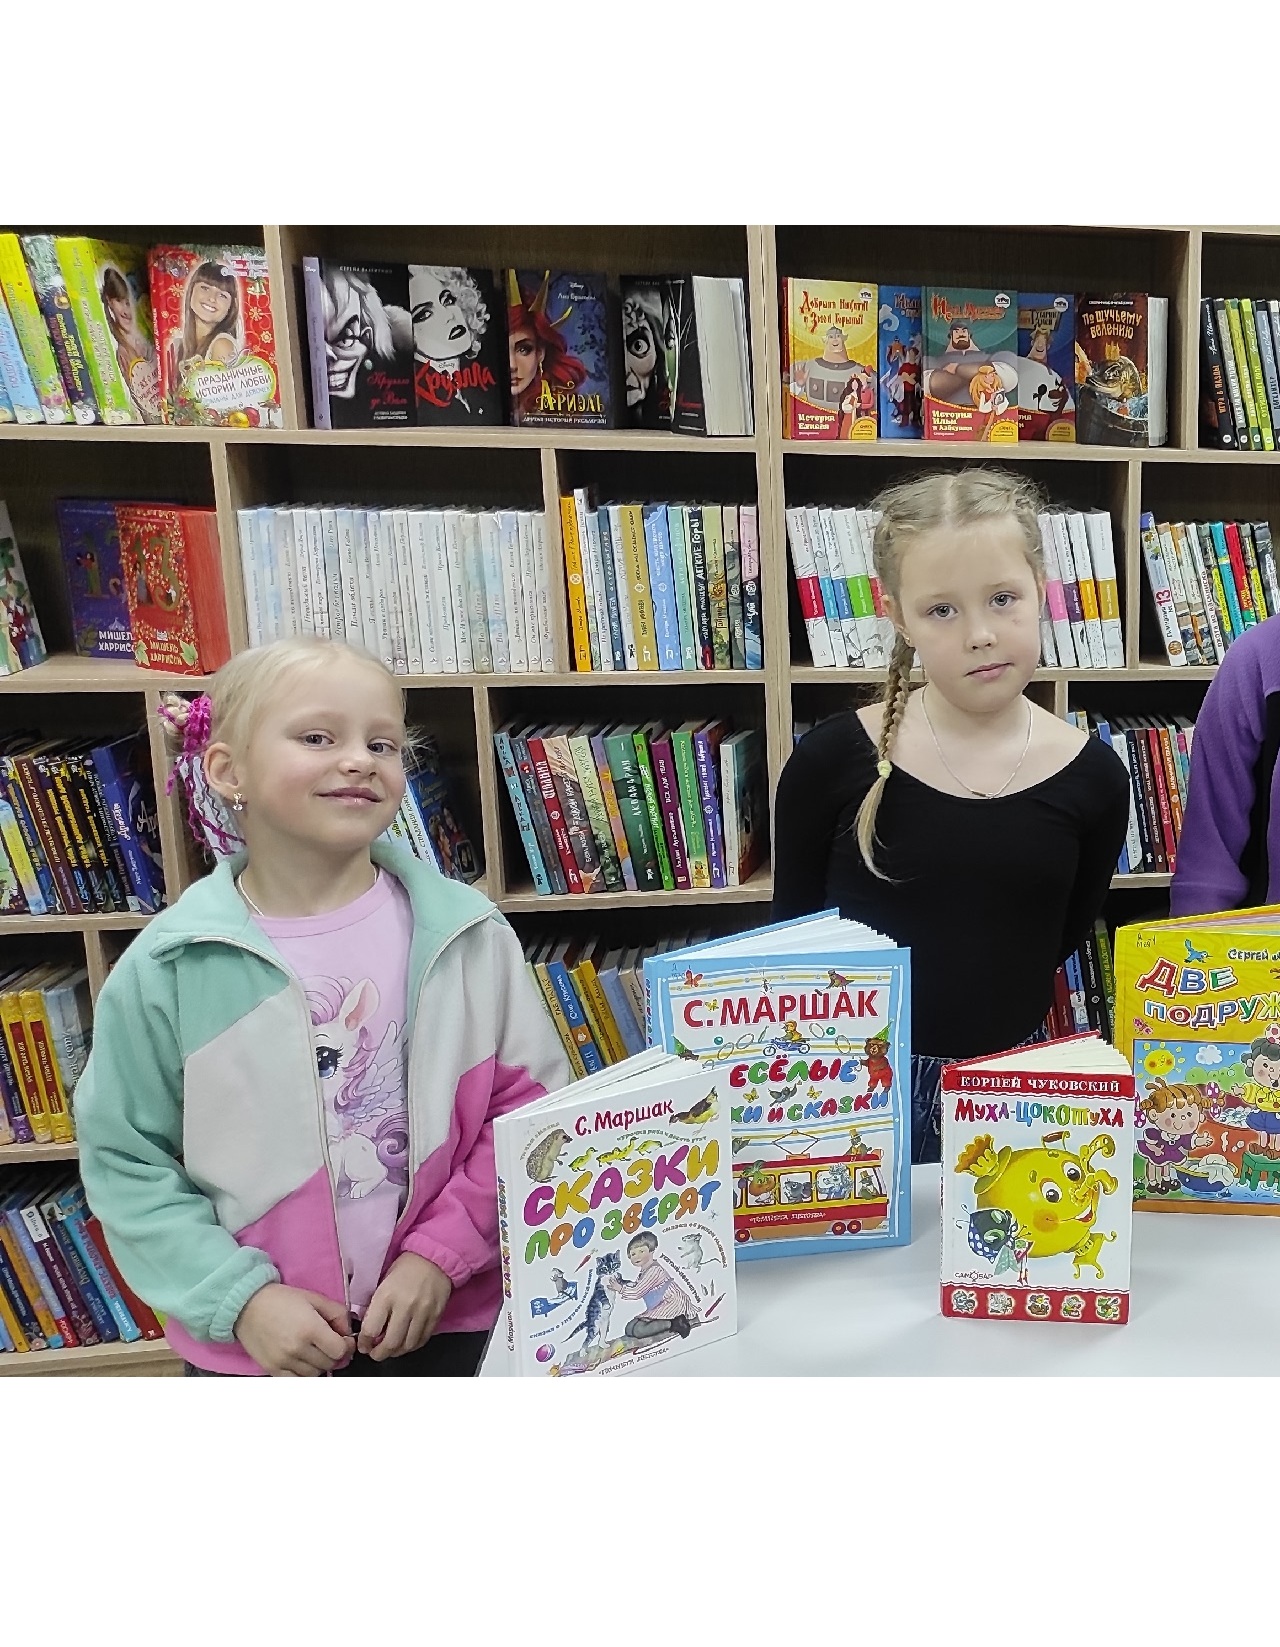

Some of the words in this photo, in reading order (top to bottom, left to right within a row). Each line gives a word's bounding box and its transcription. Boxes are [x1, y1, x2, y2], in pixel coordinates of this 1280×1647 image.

[195, 383, 236, 398] ИСТОРИИ
[240, 375, 271, 389] ЛЮБВИ
[198, 365, 264, 385] ПРАЗДНИЧНЫЕ
[1153, 588, 1172, 607] 13
[99, 631, 134, 641] МИШЕЛ
[99, 642, 135, 652] ХАРРИС
[621, 758, 642, 817] АКВАМАРИН
[1136, 956, 1238, 997] ДВЕ
[720, 990, 879, 1026] МАРШАК
[730, 1055, 857, 1088] ЕСЁЛЫЕ
[960, 1076, 1021, 1089] КОРНЕЙ
[1028, 1078, 1120, 1092] ЧУКОВСКИЙ
[595, 1099, 674, 1132] Маршак
[787, 1092, 889, 1122] СКАЗКИ
[523, 1139, 719, 1226] СКАЗКИ
[525, 1217, 596, 1264] ПРО
[601, 1181, 721, 1241] ЗВЕРЯТ
